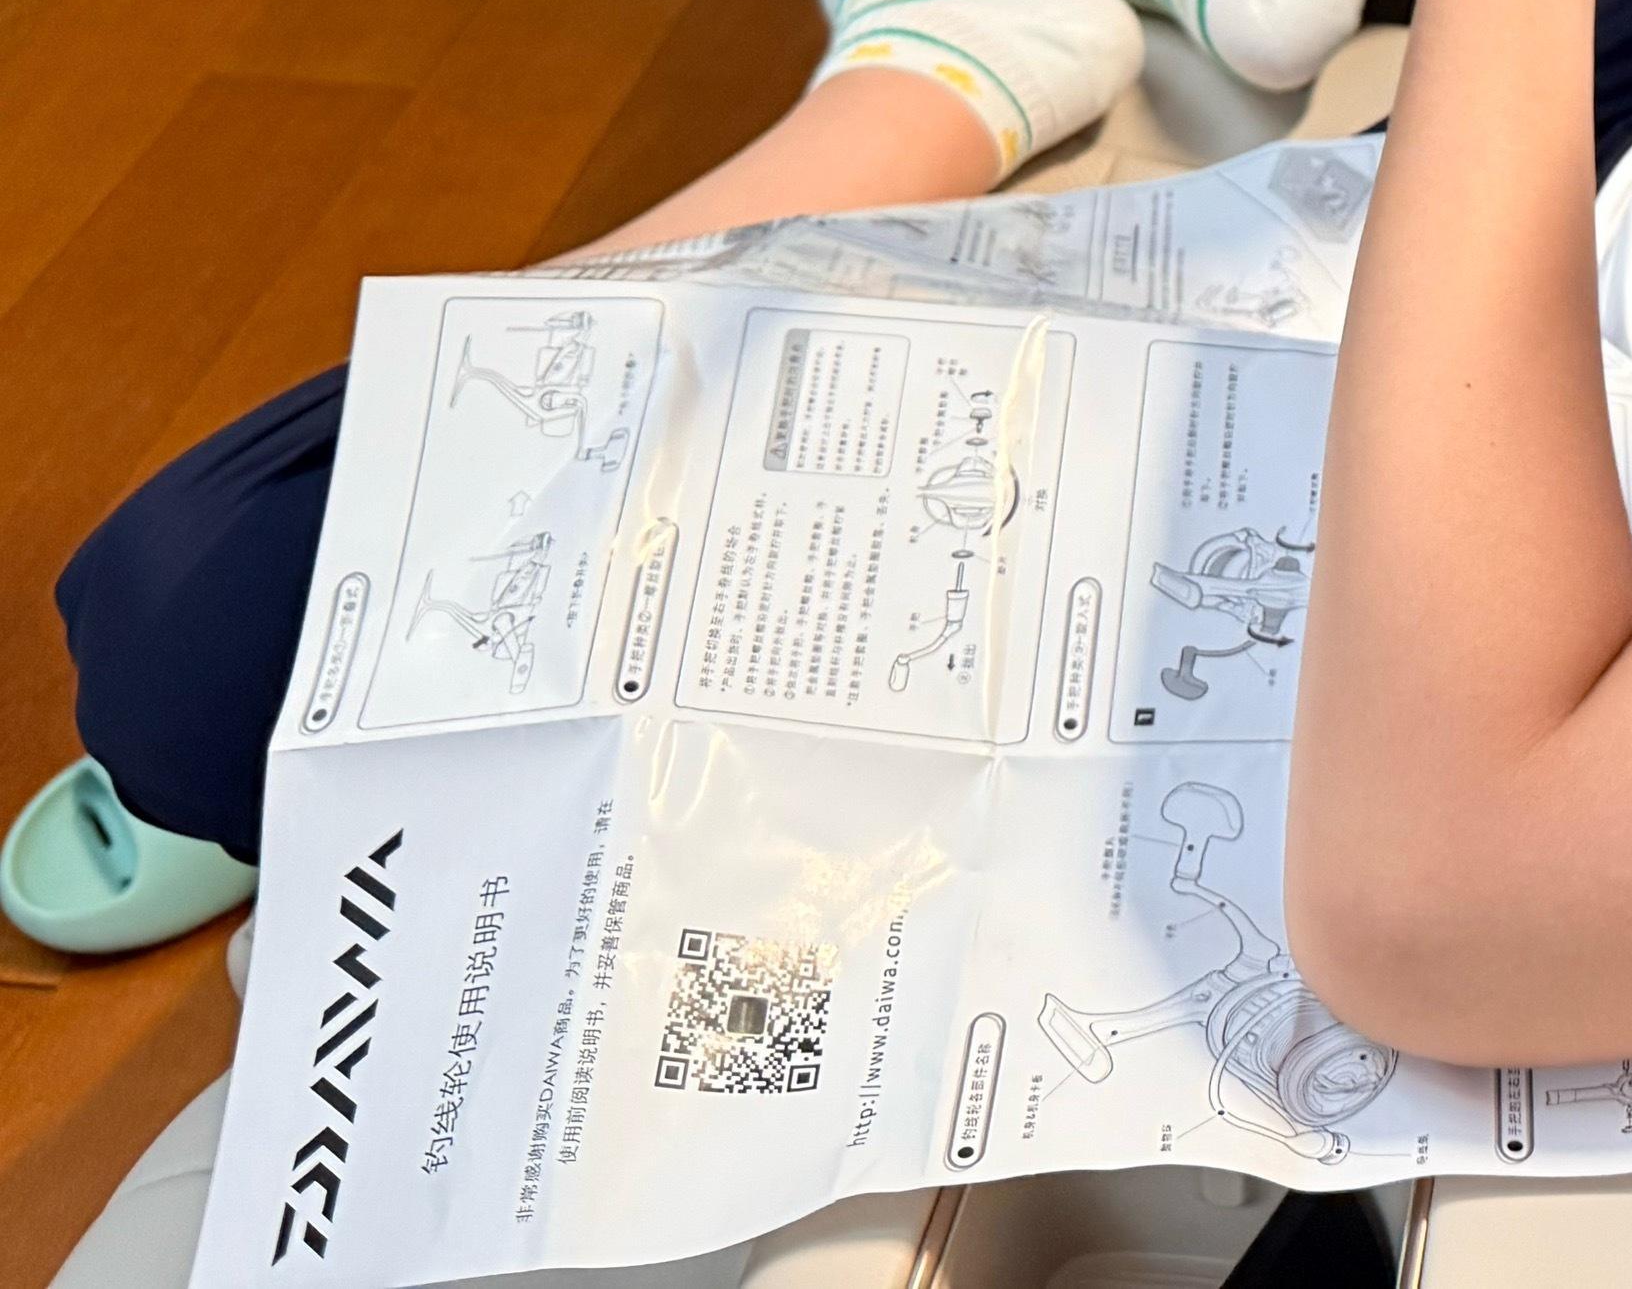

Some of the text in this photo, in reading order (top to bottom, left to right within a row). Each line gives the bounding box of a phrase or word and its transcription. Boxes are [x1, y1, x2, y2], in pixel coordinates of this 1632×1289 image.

[271, 827, 403, 1267] DAIWA
[421, 875, 510, 1175] 钓线轮使用说明书
